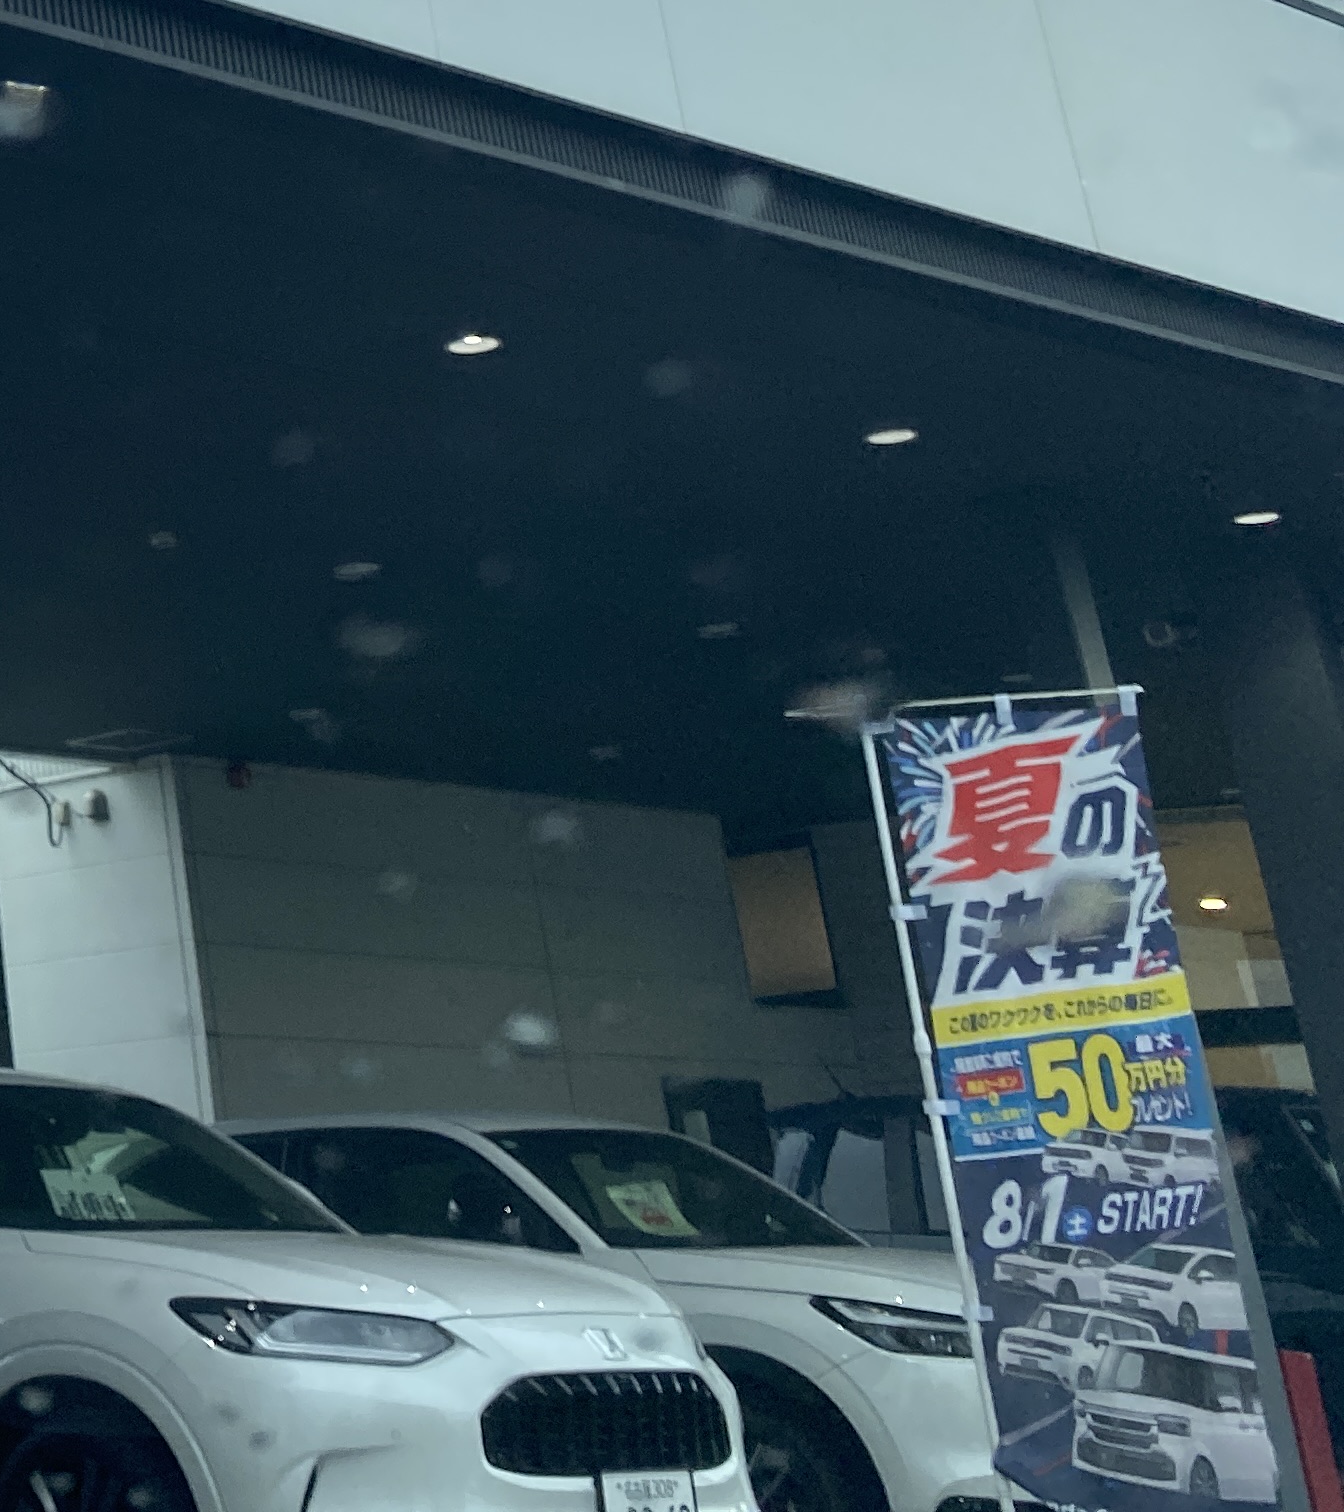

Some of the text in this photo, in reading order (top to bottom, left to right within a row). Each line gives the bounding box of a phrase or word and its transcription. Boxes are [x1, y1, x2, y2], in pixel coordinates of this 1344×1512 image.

[927, 734, 1127, 885] 夏の
[1027, 1033, 1135, 1139] 50
[982, 1174, 1069, 1249] 8/1
[1096, 1184, 1204, 1235] START!
